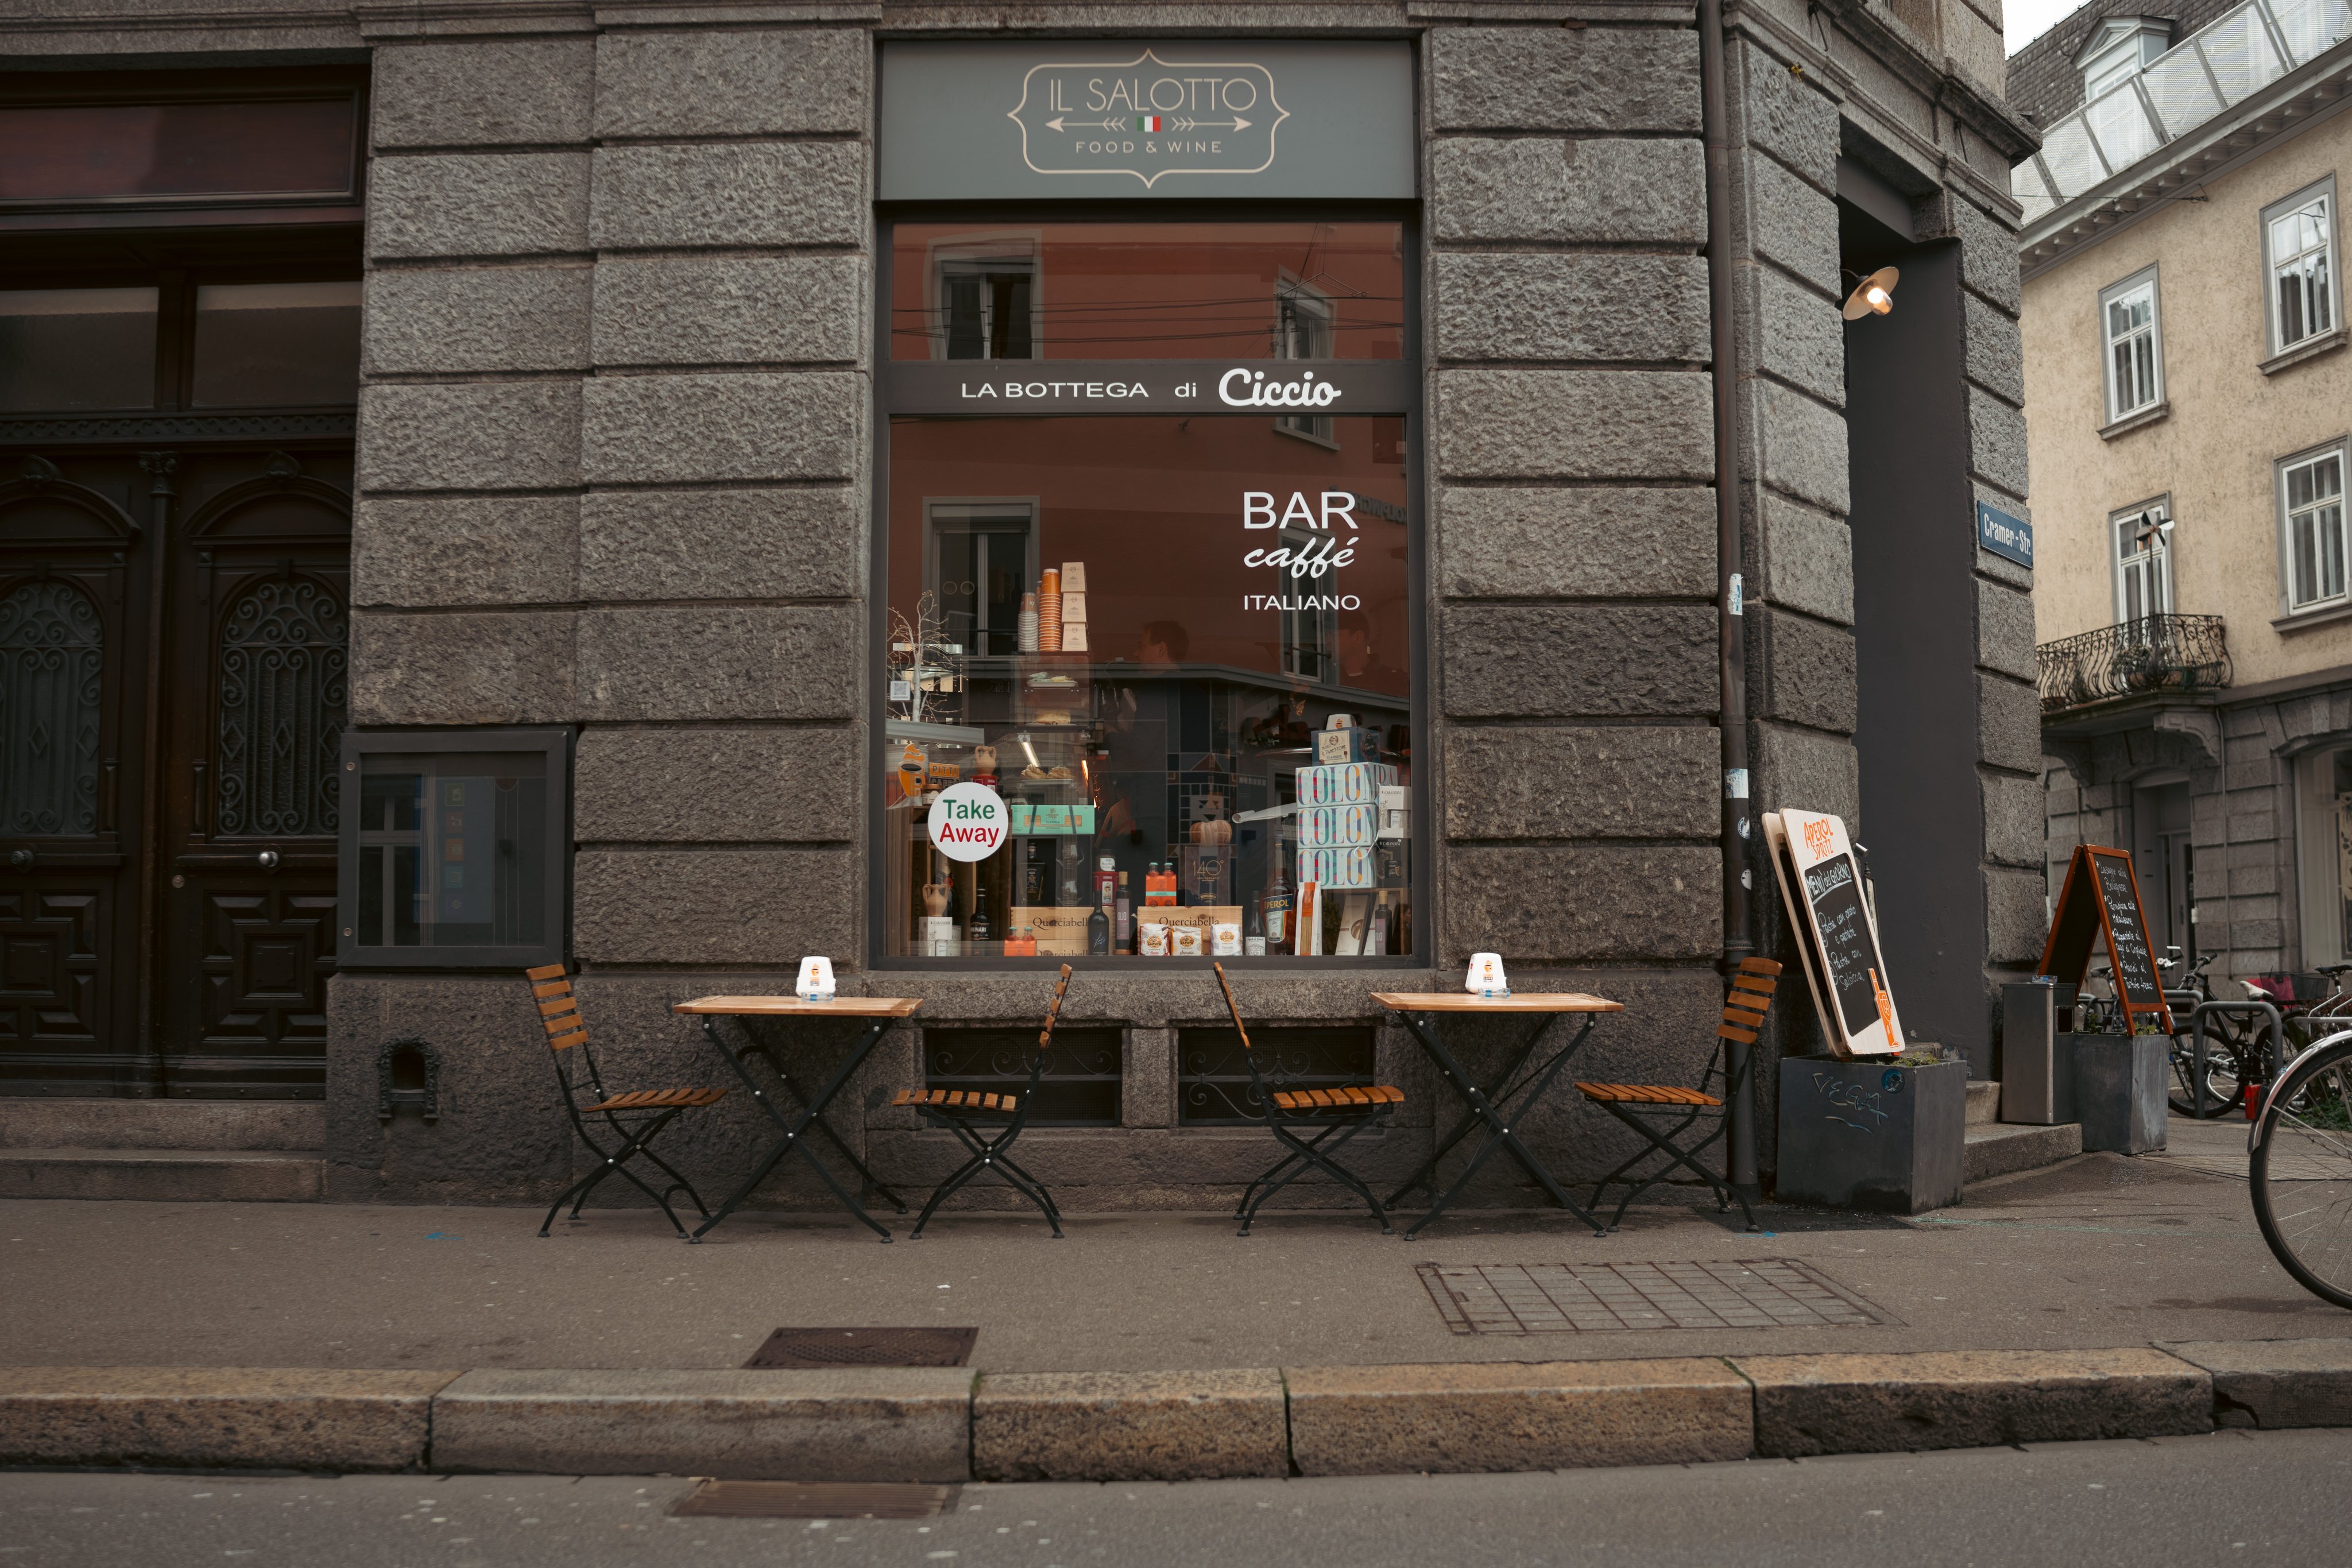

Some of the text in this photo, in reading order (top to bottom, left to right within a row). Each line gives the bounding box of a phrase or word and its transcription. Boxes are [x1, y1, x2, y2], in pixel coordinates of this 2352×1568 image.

[1050, 78, 1257, 111] IL SALOTTO
[1076, 141, 1221, 153] FOOD & WINE
[962, 367, 1342, 406] LA BOTTEGA di Ciccio
[1244, 491, 1359, 529] BAR
[1244, 536, 1360, 579] caffé
[1244, 595, 1361, 610] ITALIANO
[932, 765, 957, 775] PITTI
[942, 799, 995, 819] Take
[939, 822, 999, 847] Away
[1804, 818, 1833, 849] APEROL
[1829, 862, 1851, 885] GIORNO
[1264, 899, 1289, 909] APEROL
[1032, 917, 1088, 931] Querciabell
[1117, 912, 1127, 921] OLIO
[1817, 912, 1837, 935] Pasta
[1831, 951, 1850, 971] Pasta
